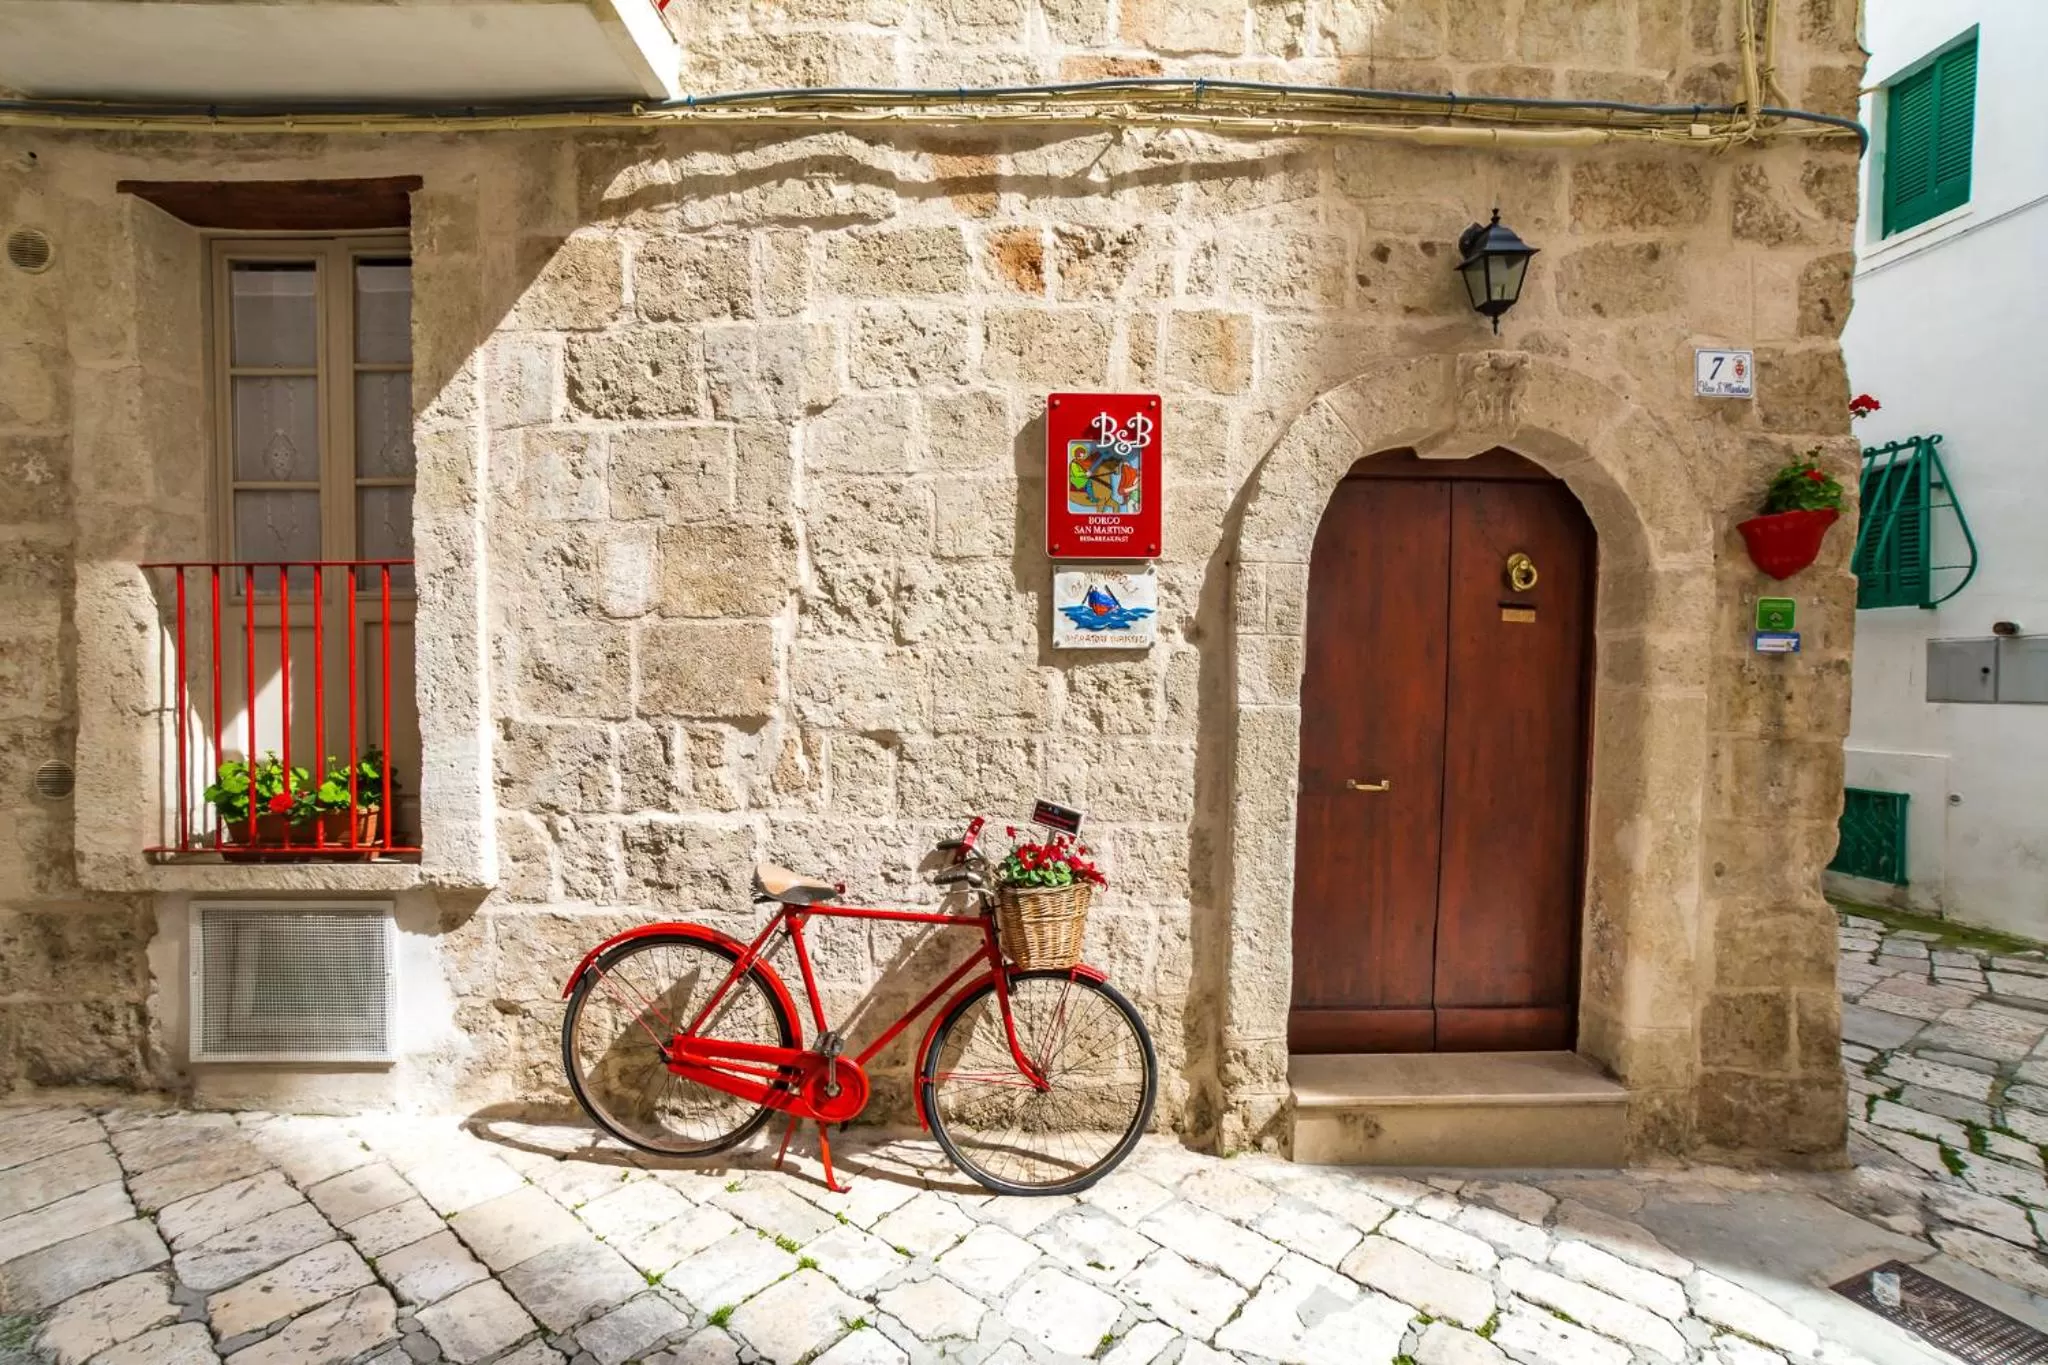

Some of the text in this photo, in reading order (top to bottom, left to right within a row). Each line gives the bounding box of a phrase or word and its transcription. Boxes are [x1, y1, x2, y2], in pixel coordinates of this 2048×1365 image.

[1710, 357, 1725, 380] 7
[1091, 411, 1153, 455] B&B
[1088, 516, 1121, 525] BORGO
[1074, 525, 1134, 535] SAN MARTINO
